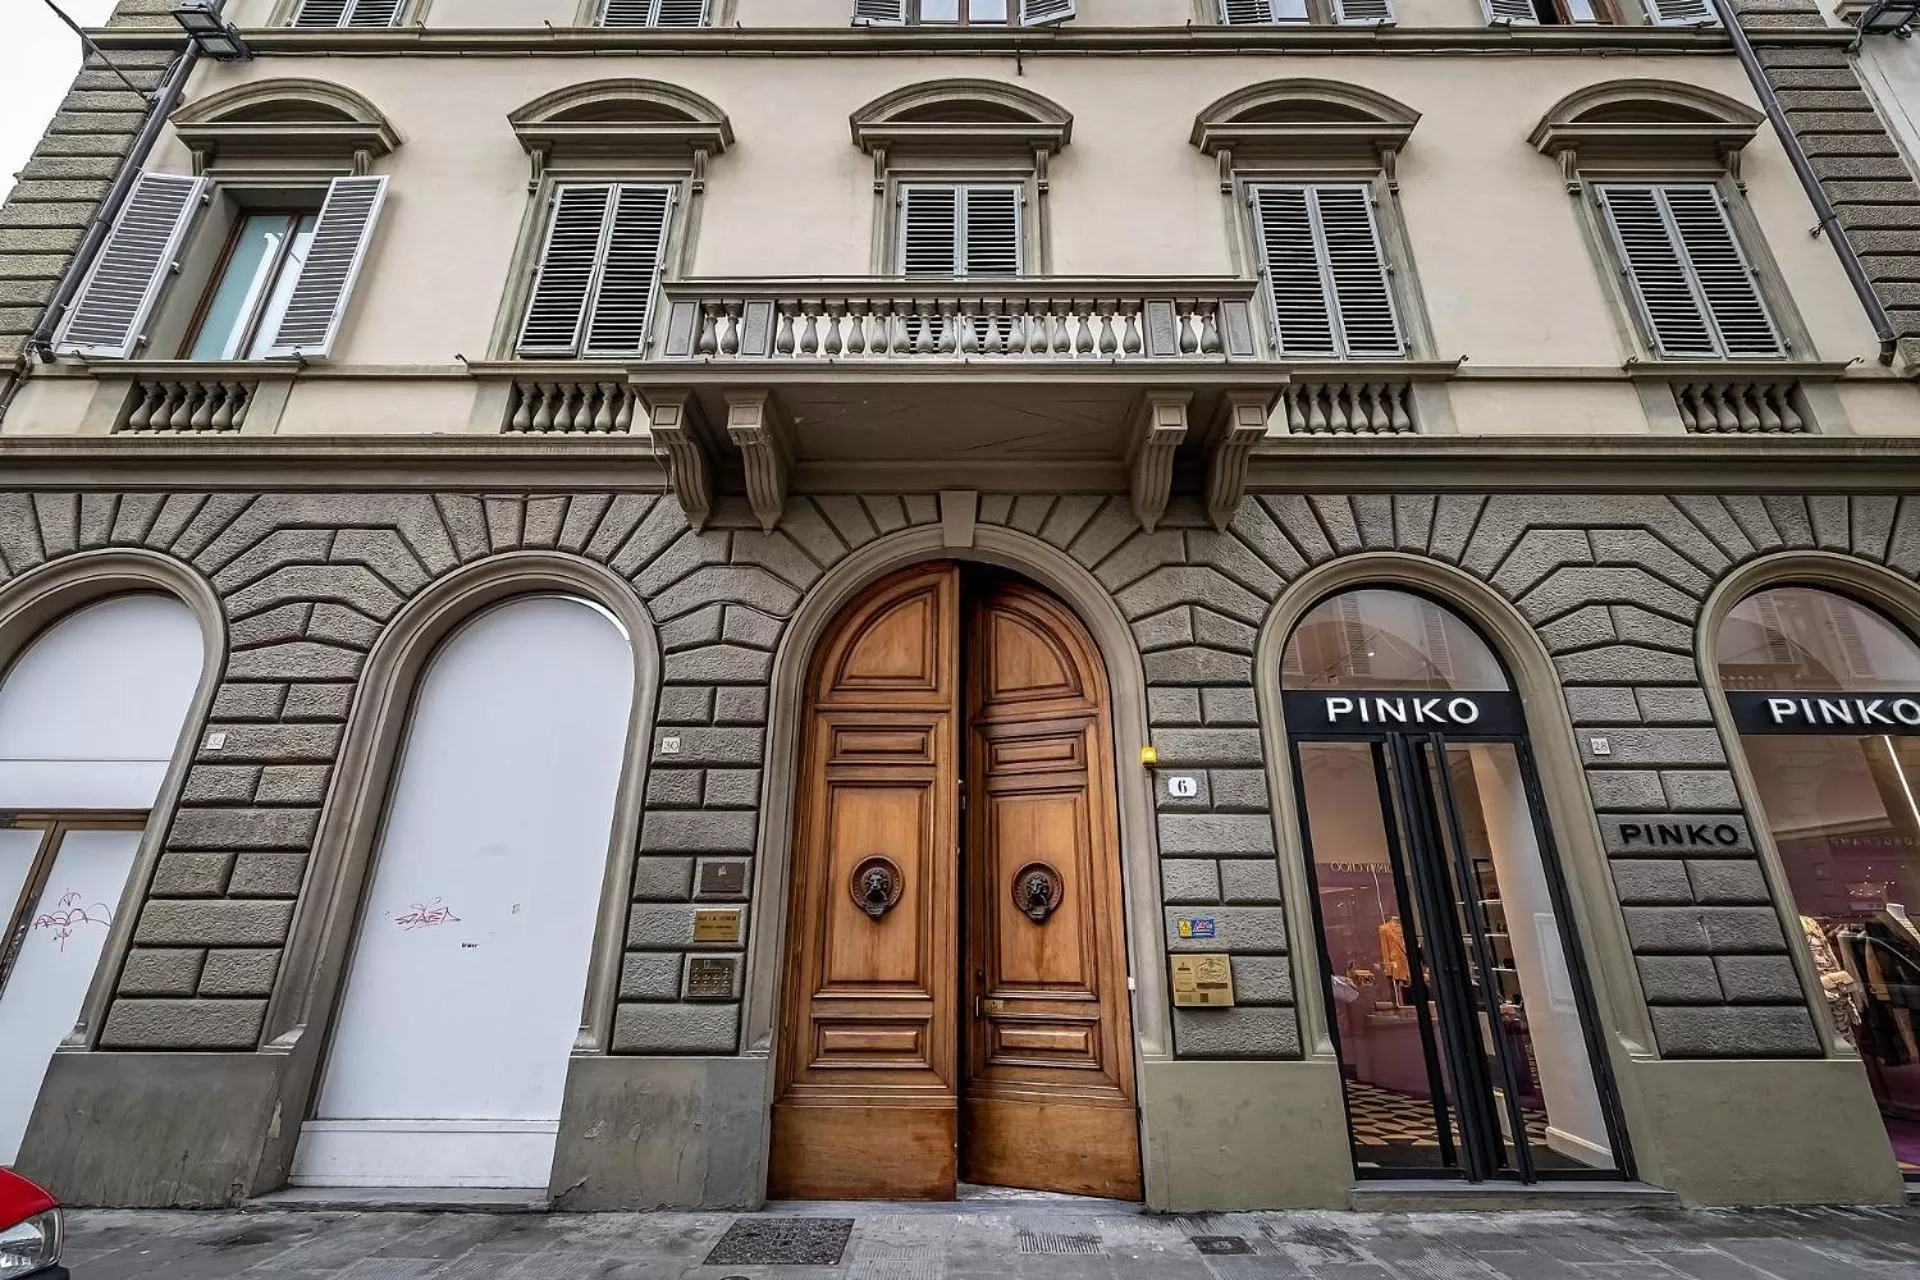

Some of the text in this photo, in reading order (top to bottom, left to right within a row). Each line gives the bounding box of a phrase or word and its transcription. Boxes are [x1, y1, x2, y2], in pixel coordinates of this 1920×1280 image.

[1325, 697, 1479, 724] PINKO
[1768, 698, 1920, 725] PINKO
[663, 740, 679, 750] 30
[1593, 740, 1608, 751] 28
[1178, 780, 1187, 793] 6
[1619, 824, 1738, 845] PINKO
